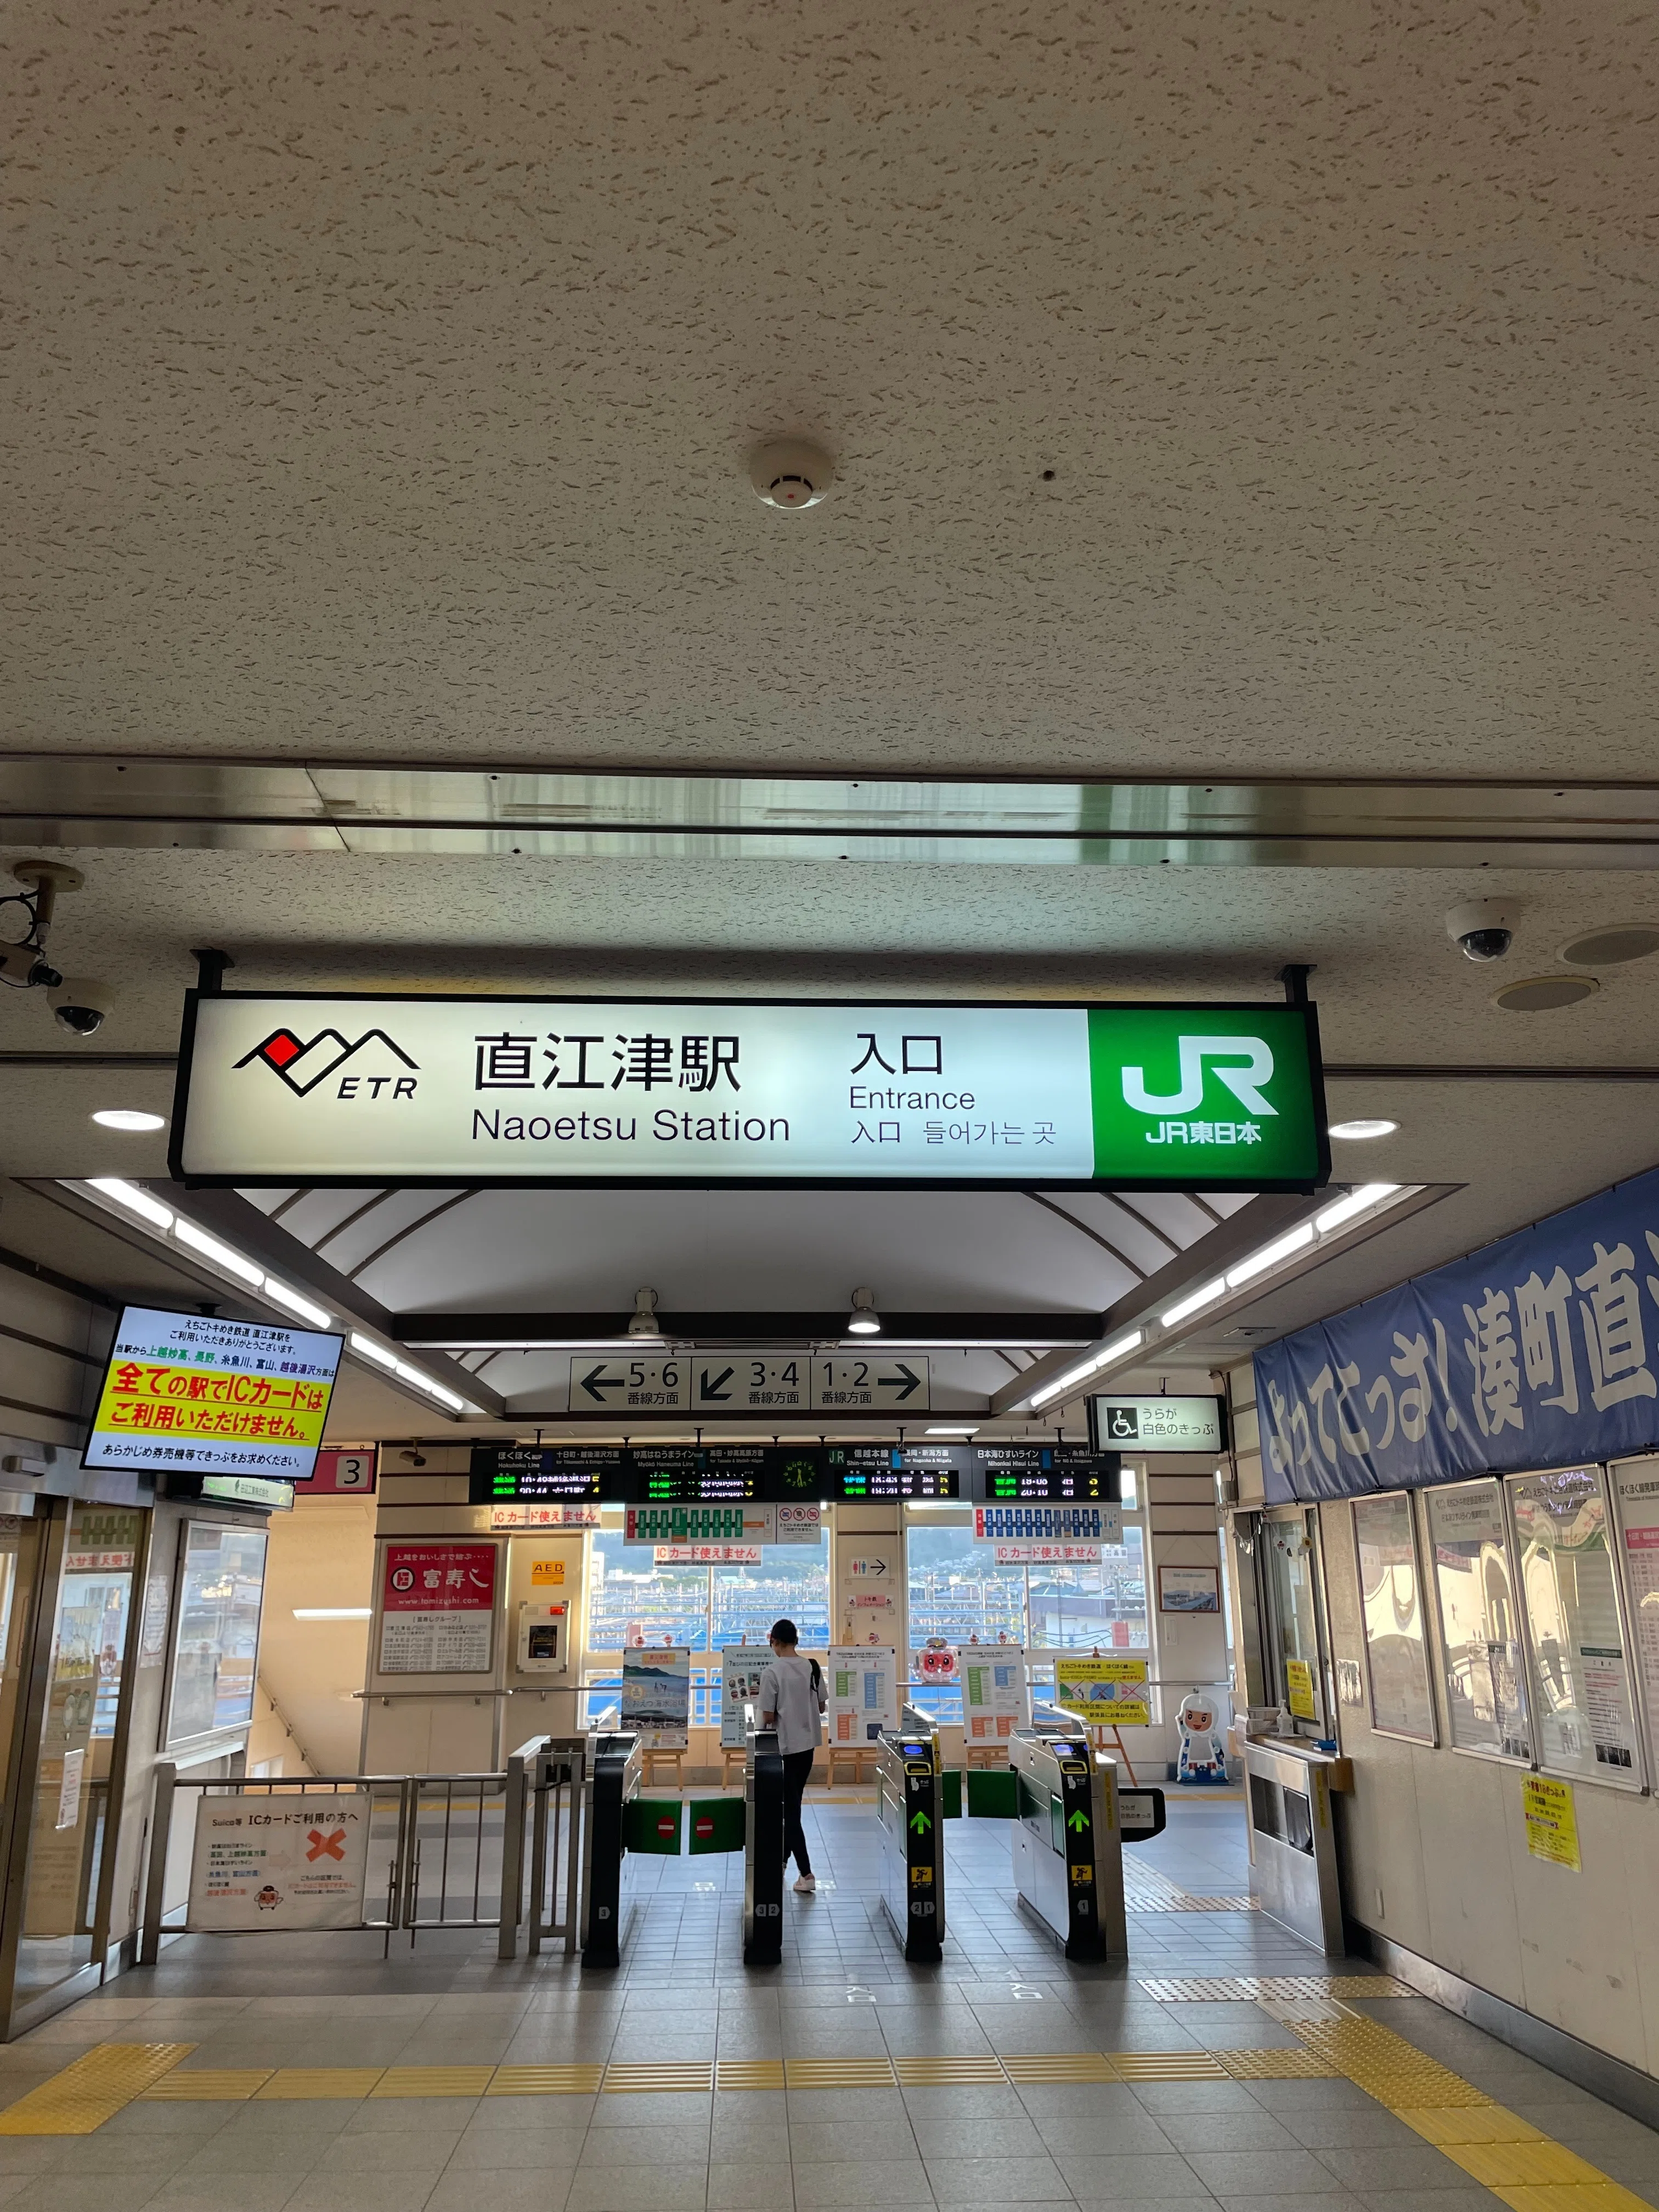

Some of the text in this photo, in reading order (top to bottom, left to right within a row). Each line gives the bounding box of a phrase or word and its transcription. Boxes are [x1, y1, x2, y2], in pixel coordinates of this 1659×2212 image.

[474, 1031, 739, 1092] 直江津駅
[850, 1032, 943, 1076] 入口
[1122, 1036, 1279, 1115] JR
[336, 1077, 419, 1099] ETR
[850, 1085, 975, 1110] Entrance
[473, 1108, 790, 1142] Naoetsu Station
[851, 1121, 901, 1144] 入口
[923, 1120, 1057, 1146] 들어가는 곳
[1145, 1121, 1262, 1146] JR東日本
[185, 1320, 291, 1342] えちごトキめき鉄道 直江津駅を
[170, 1330, 296, 1355] ご利用いただきありがとうございます。
[112, 1362, 324, 1410] 全ての駅でICカードは
[628, 1392, 679, 1405] 番線方面
[748, 1391, 799, 1404] 番線方面
[821, 1391, 872, 1404] 番線方面
[111, 1402, 306, 1440] ご利用いただけません。
[1143, 1408, 1177, 1420] うらが
[1143, 1423, 1214, 1435] 白色のきっぷ
[103, 1444, 300, 1468] あらかじめ券売機等できっぷをお求めください。
[854, 1449, 889, 1458] 信越本線
[978, 1450, 1039, 1459] 日本海ひすいライン
[343, 1459, 360, 1484] 3
[494, 1510, 596, 1523] ICカード使えません
[657, 1547, 757, 1559] ICカード使えません
[998, 1545, 1097, 1559] ICカード使えません
[423, 1568, 489, 1589] 富寿し
[249, 1812, 359, 1826] ICカードご利用の方へ
